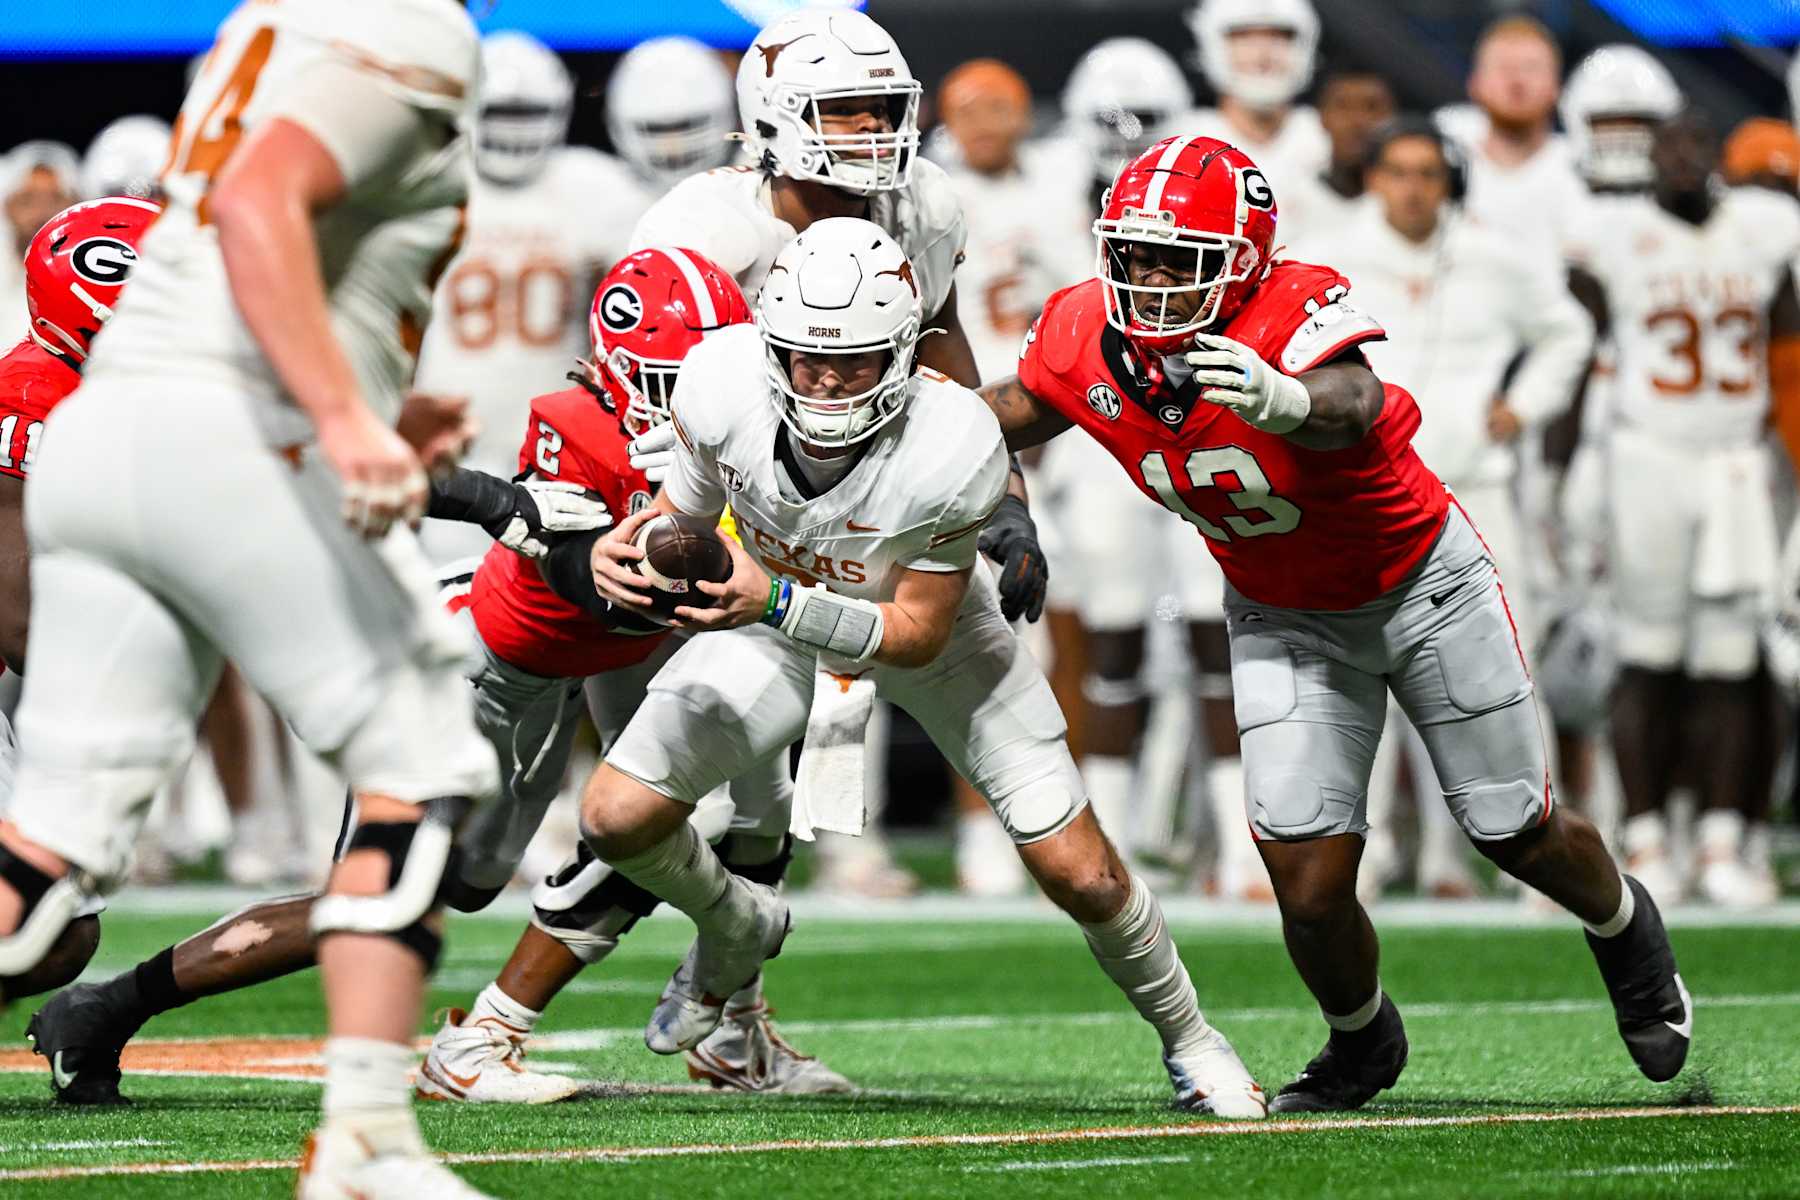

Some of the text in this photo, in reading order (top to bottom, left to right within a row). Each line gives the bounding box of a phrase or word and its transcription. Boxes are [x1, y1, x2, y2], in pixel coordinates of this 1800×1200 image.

[868, 68, 896, 78] HORNS
[1242, 169, 1273, 208] G
[72, 239, 138, 283] G
[449, 258, 572, 348] 80
[601, 286, 641, 329] G
[808, 326, 842, 338] HORNS
[1645, 306, 1758, 394] 33
[1088, 385, 1120, 418] SEC
[1158, 404, 1184, 425] G
[535, 421, 562, 476] 2
[1138, 444, 1303, 543] 13
[730, 511, 866, 584] TEXAS
